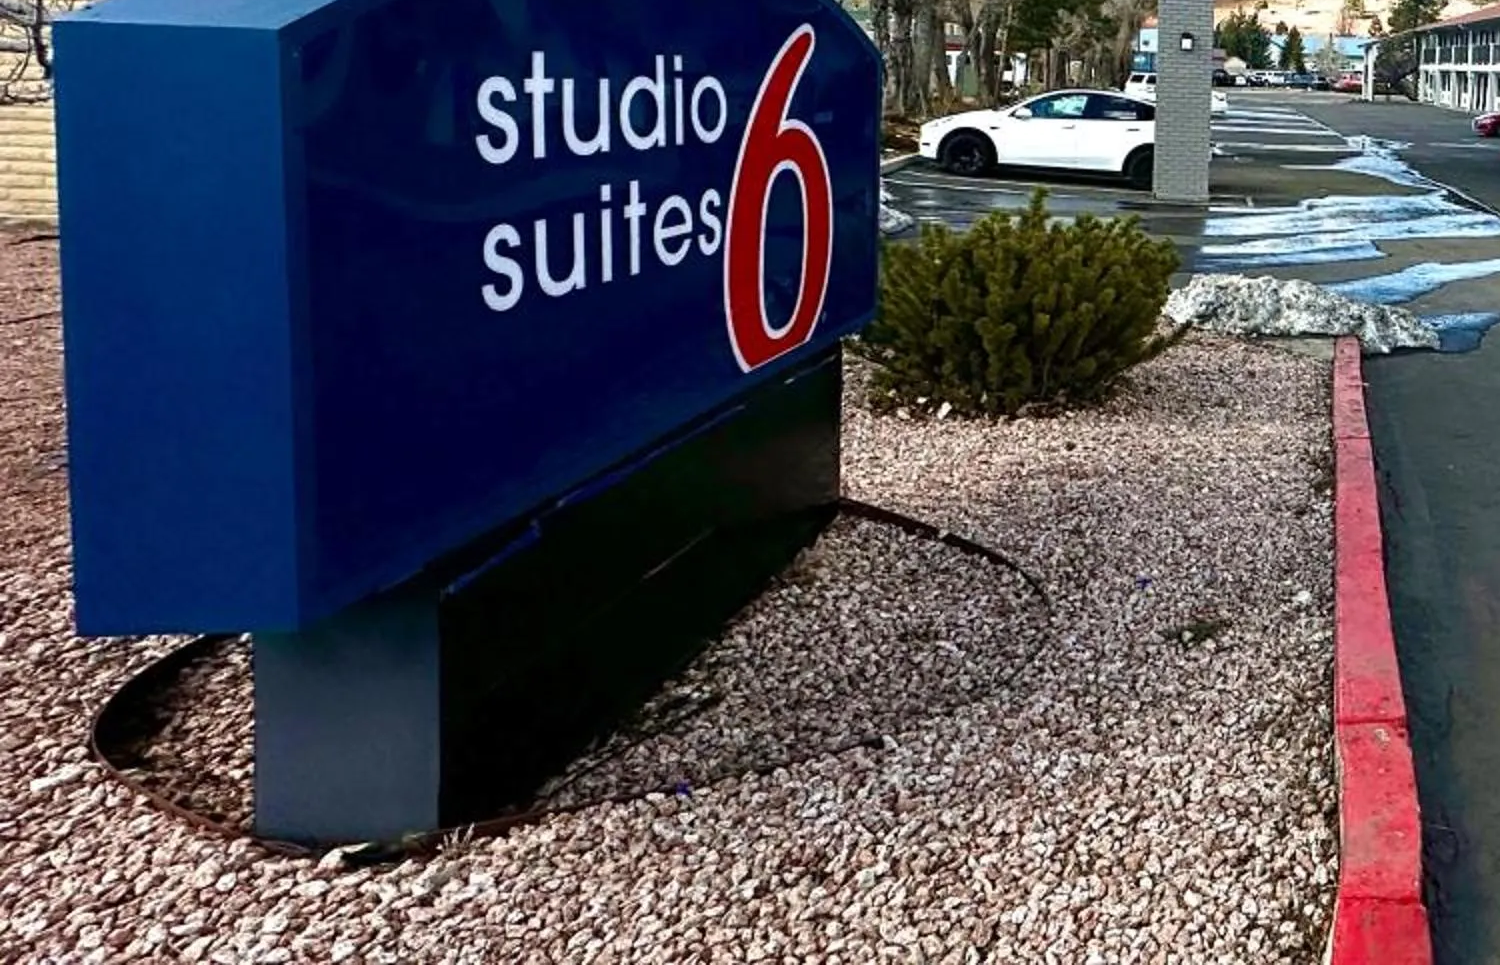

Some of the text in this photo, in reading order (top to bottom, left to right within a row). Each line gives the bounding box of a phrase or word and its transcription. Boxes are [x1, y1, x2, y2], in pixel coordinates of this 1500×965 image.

[475, 51, 727, 164] studio
[481, 180, 723, 311] suites
[723, 23, 833, 373] 6
